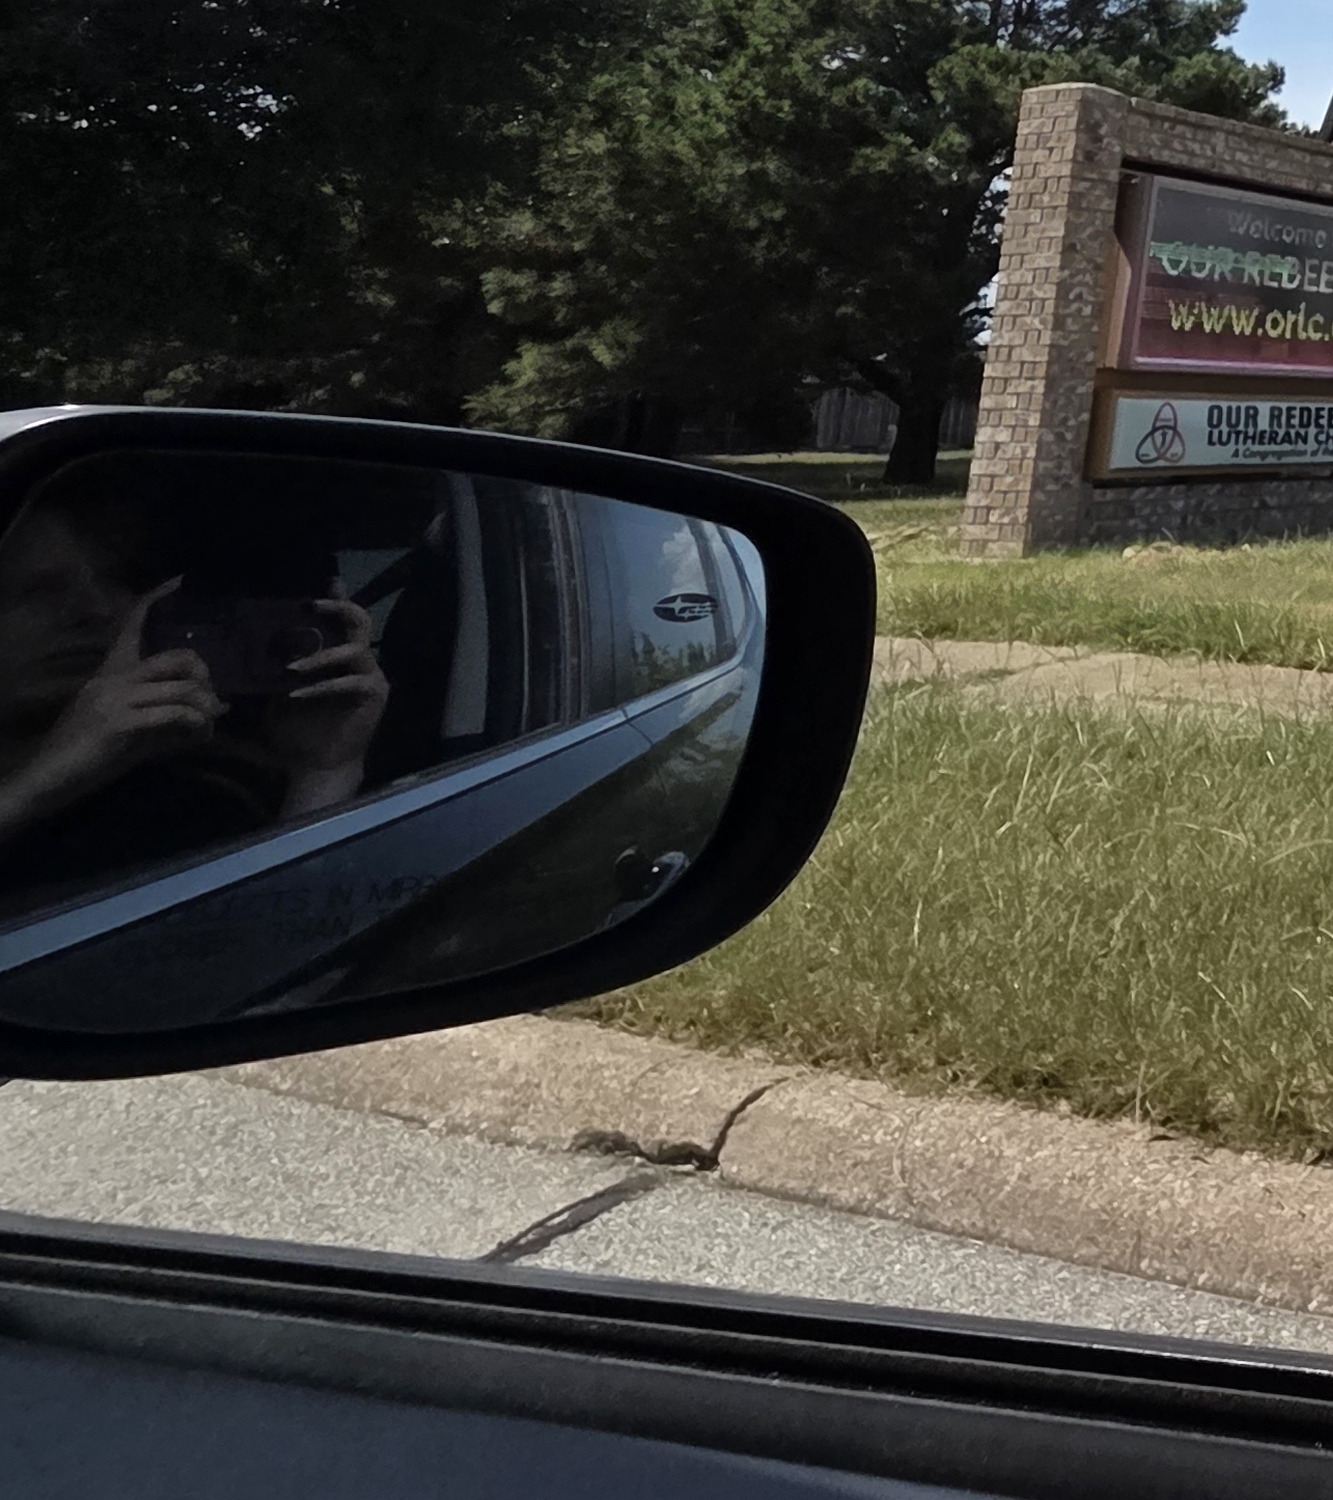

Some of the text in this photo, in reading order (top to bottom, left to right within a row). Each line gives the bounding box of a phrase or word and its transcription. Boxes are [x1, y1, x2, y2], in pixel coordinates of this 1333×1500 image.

[1226, 210, 1327, 249] Welcome
[1162, 243, 1234, 283] OUR
[1207, 404, 1259, 429] OUR
[1207, 429, 1308, 447] LUTHERAN
